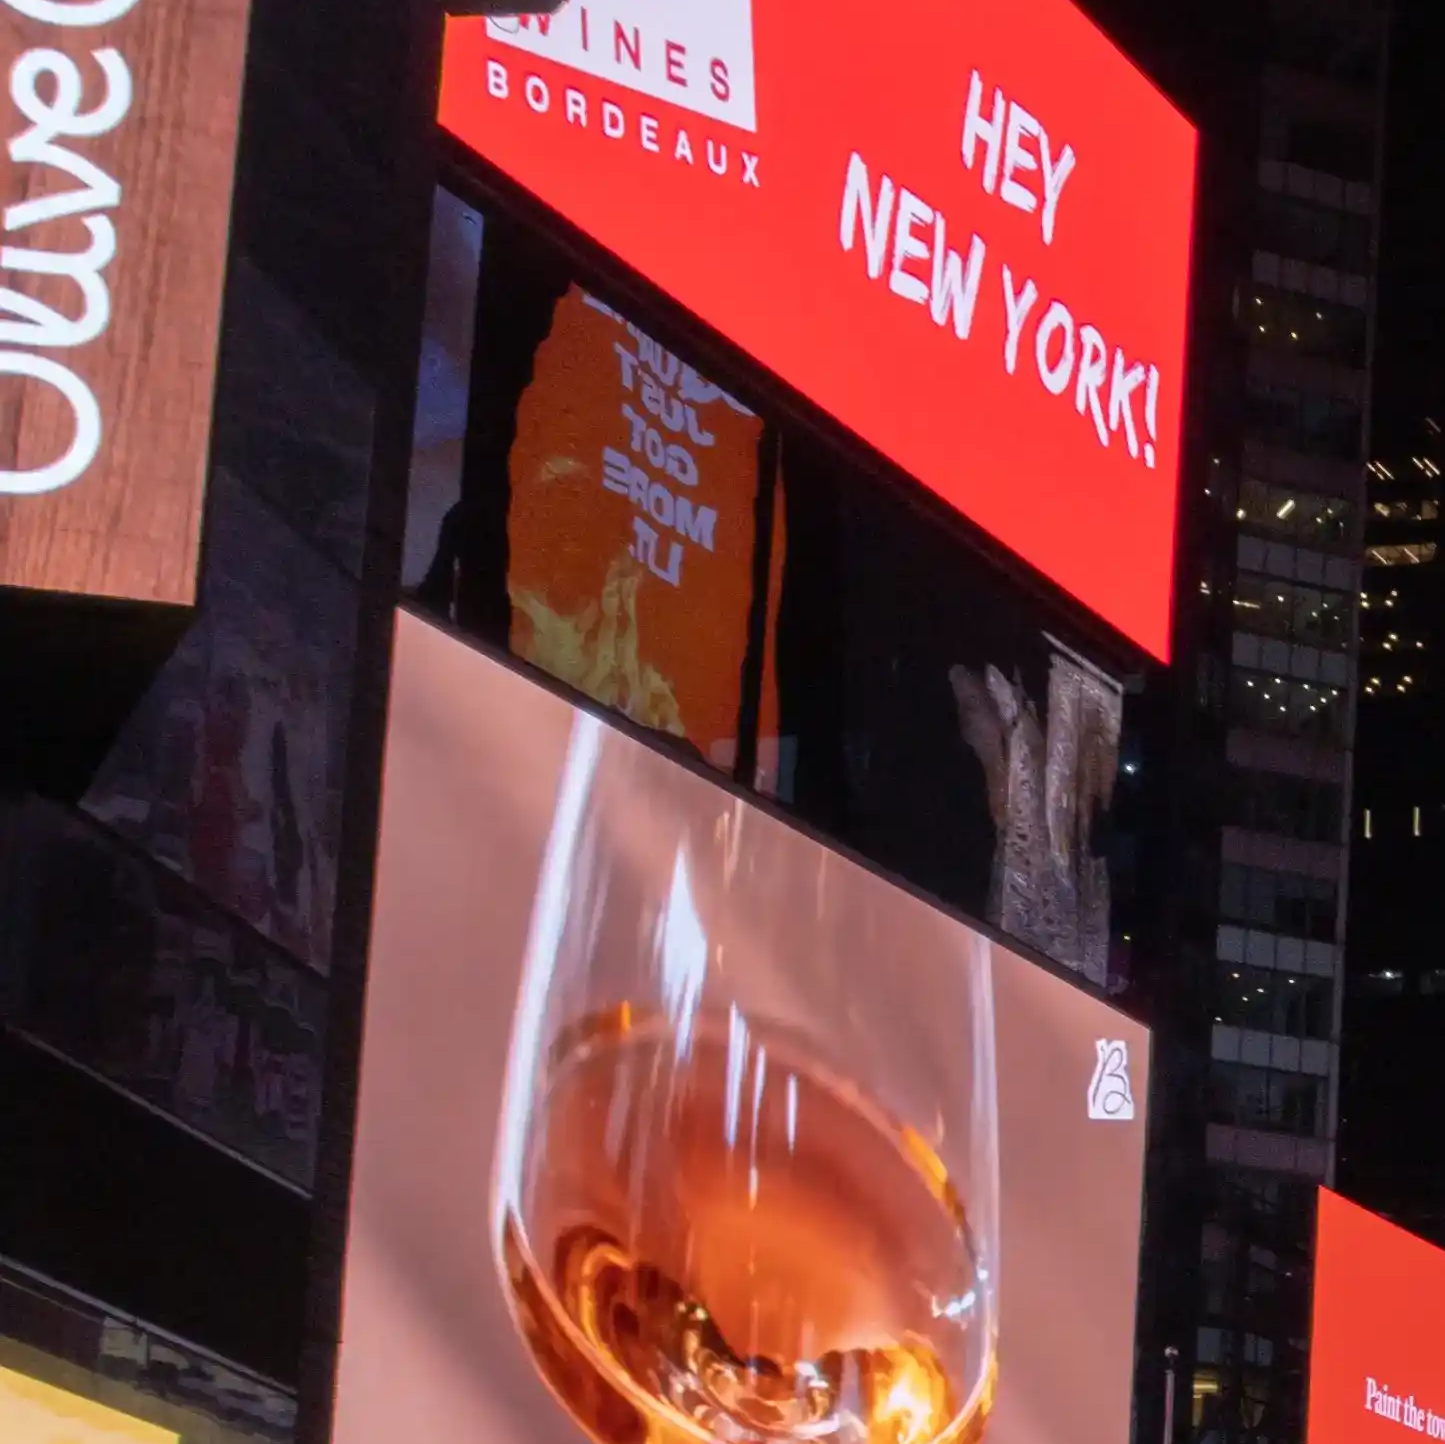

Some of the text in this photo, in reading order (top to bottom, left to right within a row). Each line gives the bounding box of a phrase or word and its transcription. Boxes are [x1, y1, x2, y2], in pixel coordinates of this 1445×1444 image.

[488, 61, 761, 187] BORDEAUX
[962, 68, 1076, 246] HEY
[840, 151, 1160, 468] NEW YORK!
[1365, 1376, 1402, 1424] Paint
[1403, 1394, 1425, 1432] the
